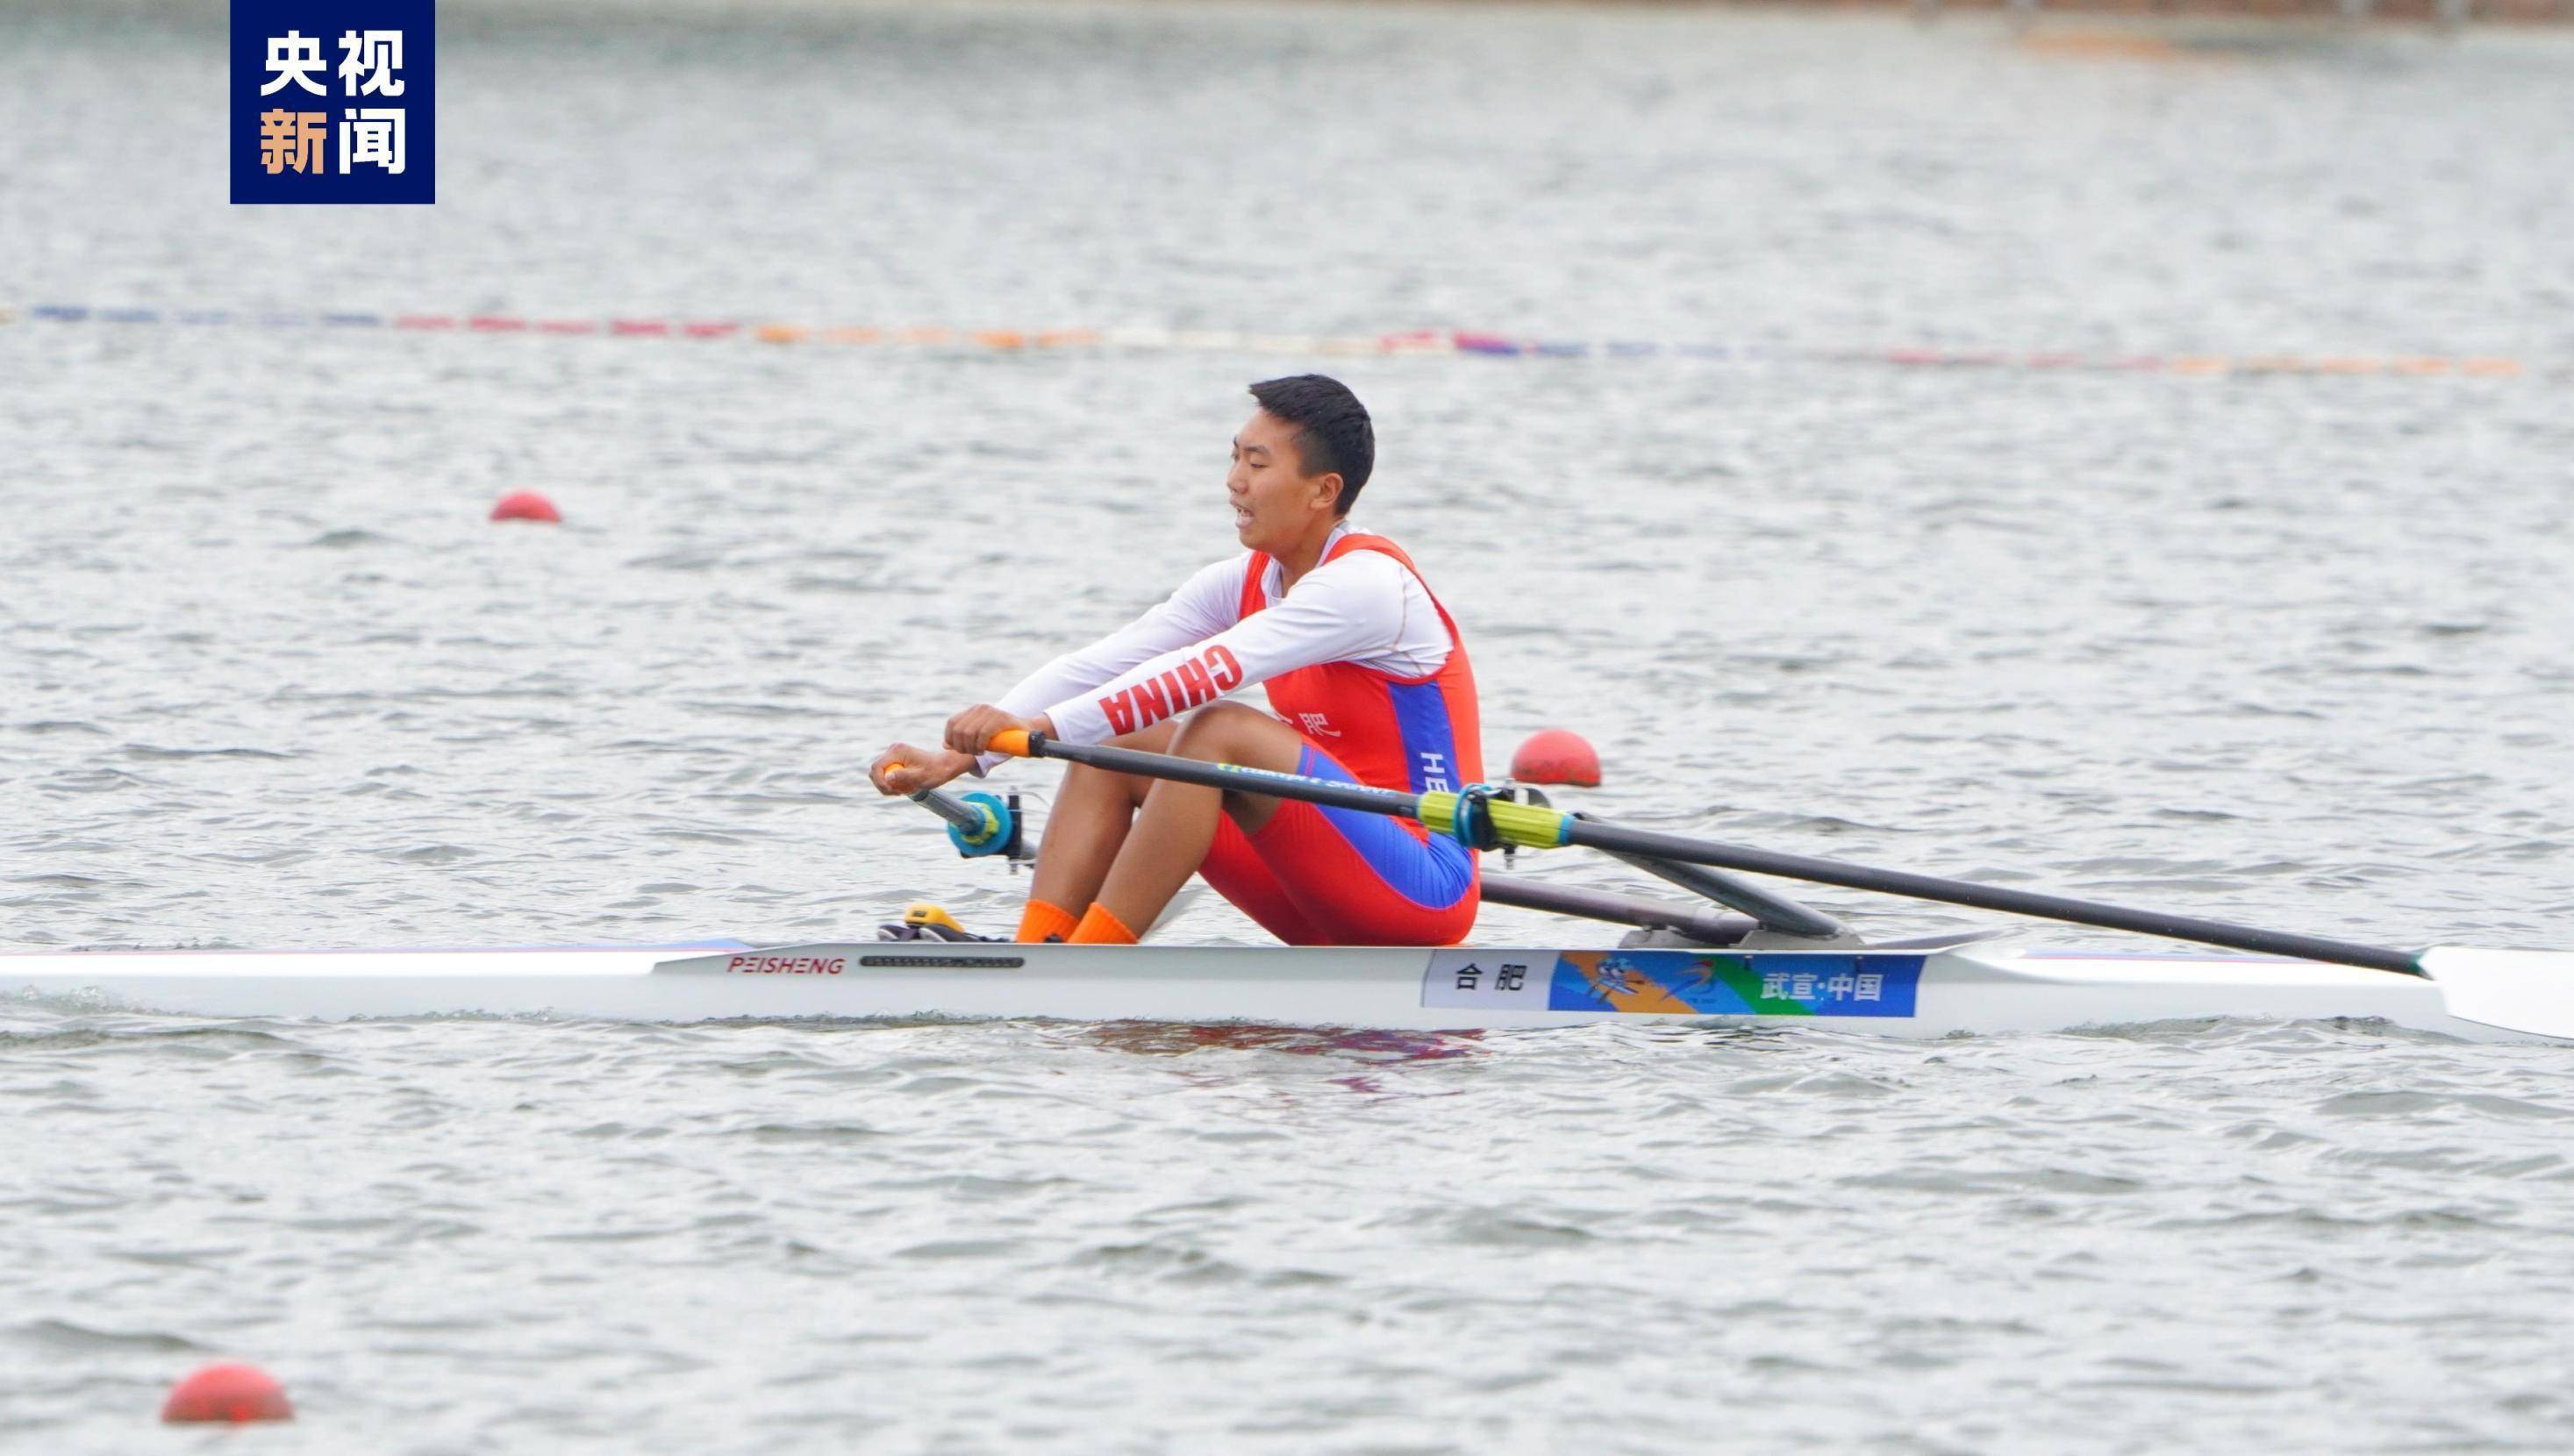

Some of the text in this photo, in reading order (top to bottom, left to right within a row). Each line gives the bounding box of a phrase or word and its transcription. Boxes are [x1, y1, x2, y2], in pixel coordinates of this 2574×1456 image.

[1098, 645, 1243, 737] CHINA
[1276, 712, 1341, 738] 肥
[727, 957, 845, 974] PEISHENG
[1456, 963, 1527, 991] 合肥
